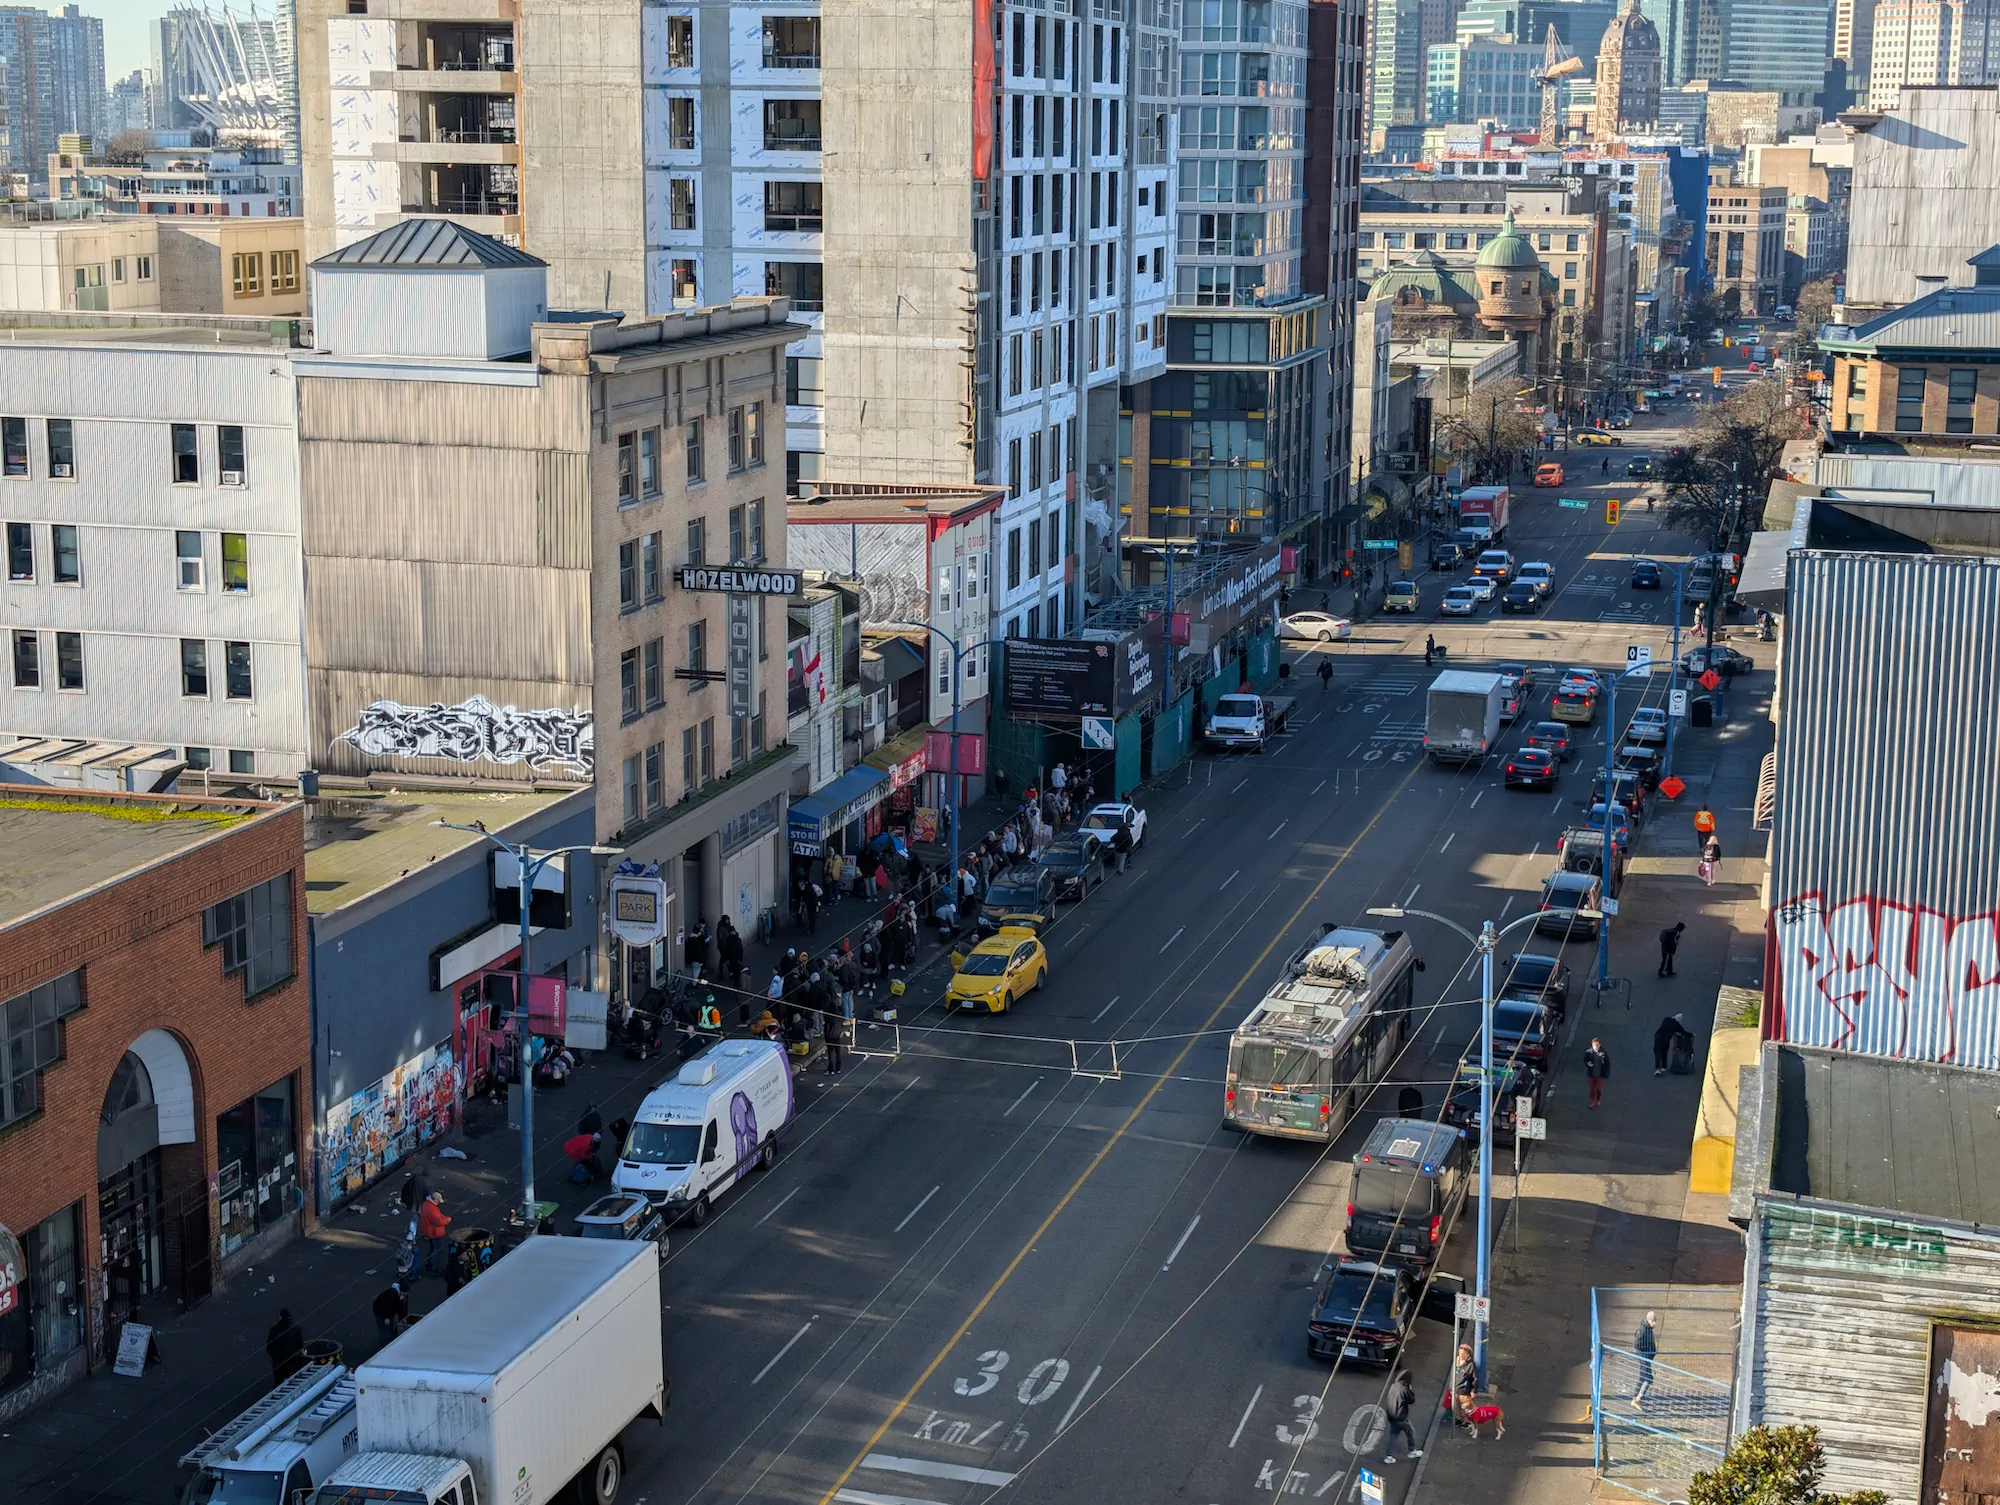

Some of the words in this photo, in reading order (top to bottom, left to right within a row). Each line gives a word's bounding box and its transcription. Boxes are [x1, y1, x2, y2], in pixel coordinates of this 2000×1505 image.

[683, 569, 796, 593] HAZELWOOD
[732, 599, 748, 707] HOTEL
[790, 830, 818, 840] STORE
[794, 844, 819, 857] ATM
[620, 894, 652, 903] PIGEON
[620, 902, 652, 914] PARK
[954, 1350, 1070, 1406] 30
[913, 1411, 1030, 1452] km/h
[1275, 1395, 1388, 1456] 30
